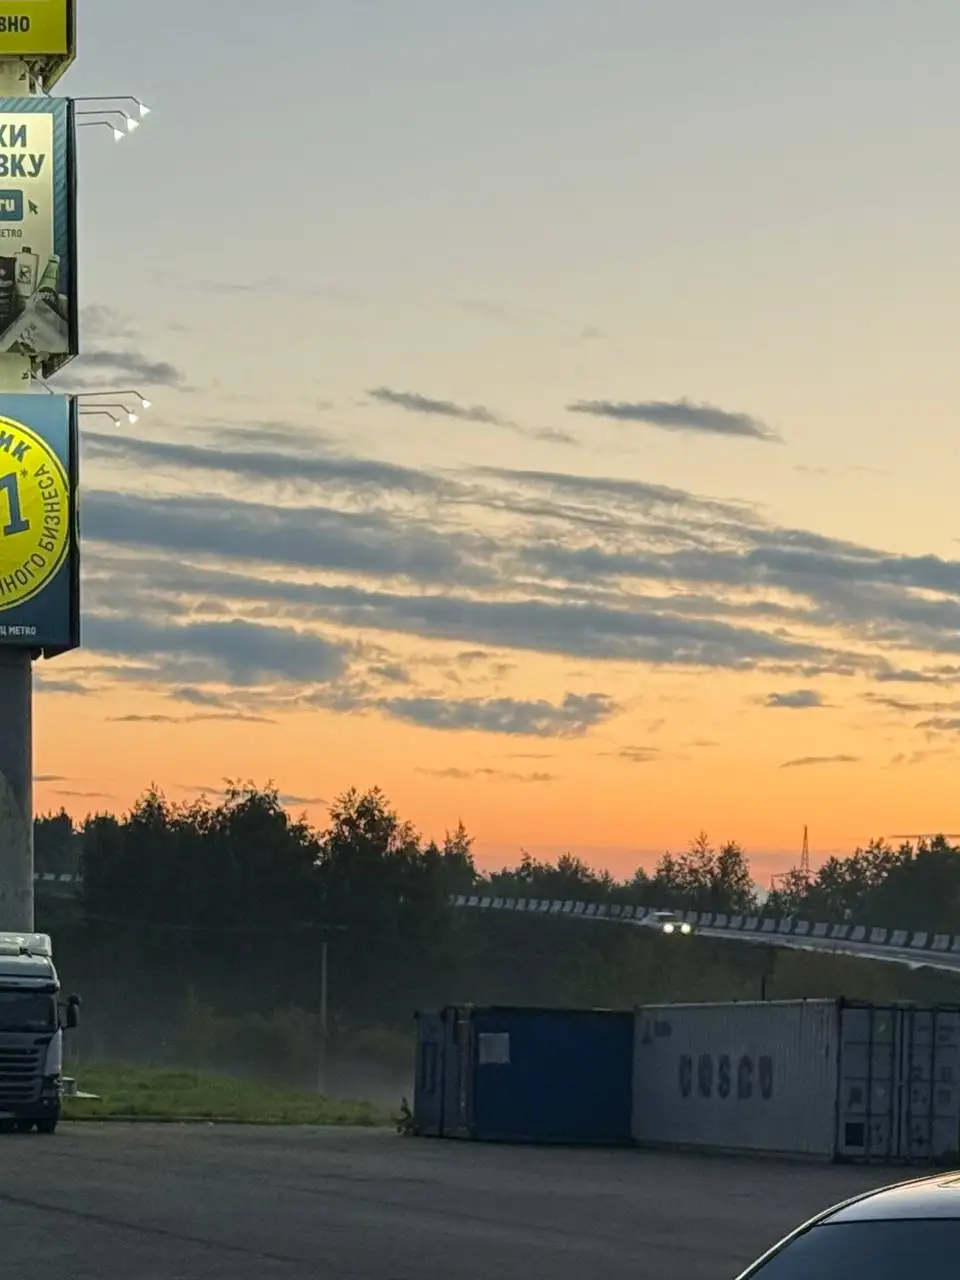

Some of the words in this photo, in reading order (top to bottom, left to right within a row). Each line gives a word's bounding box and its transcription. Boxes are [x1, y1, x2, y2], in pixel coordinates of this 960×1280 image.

[0, 228, 22, 239] ETRO
[0, 553, 46, 596] НОГО
[34, 463, 61, 552] БИЗНЕСА
[8, 626, 37, 636] METRO
